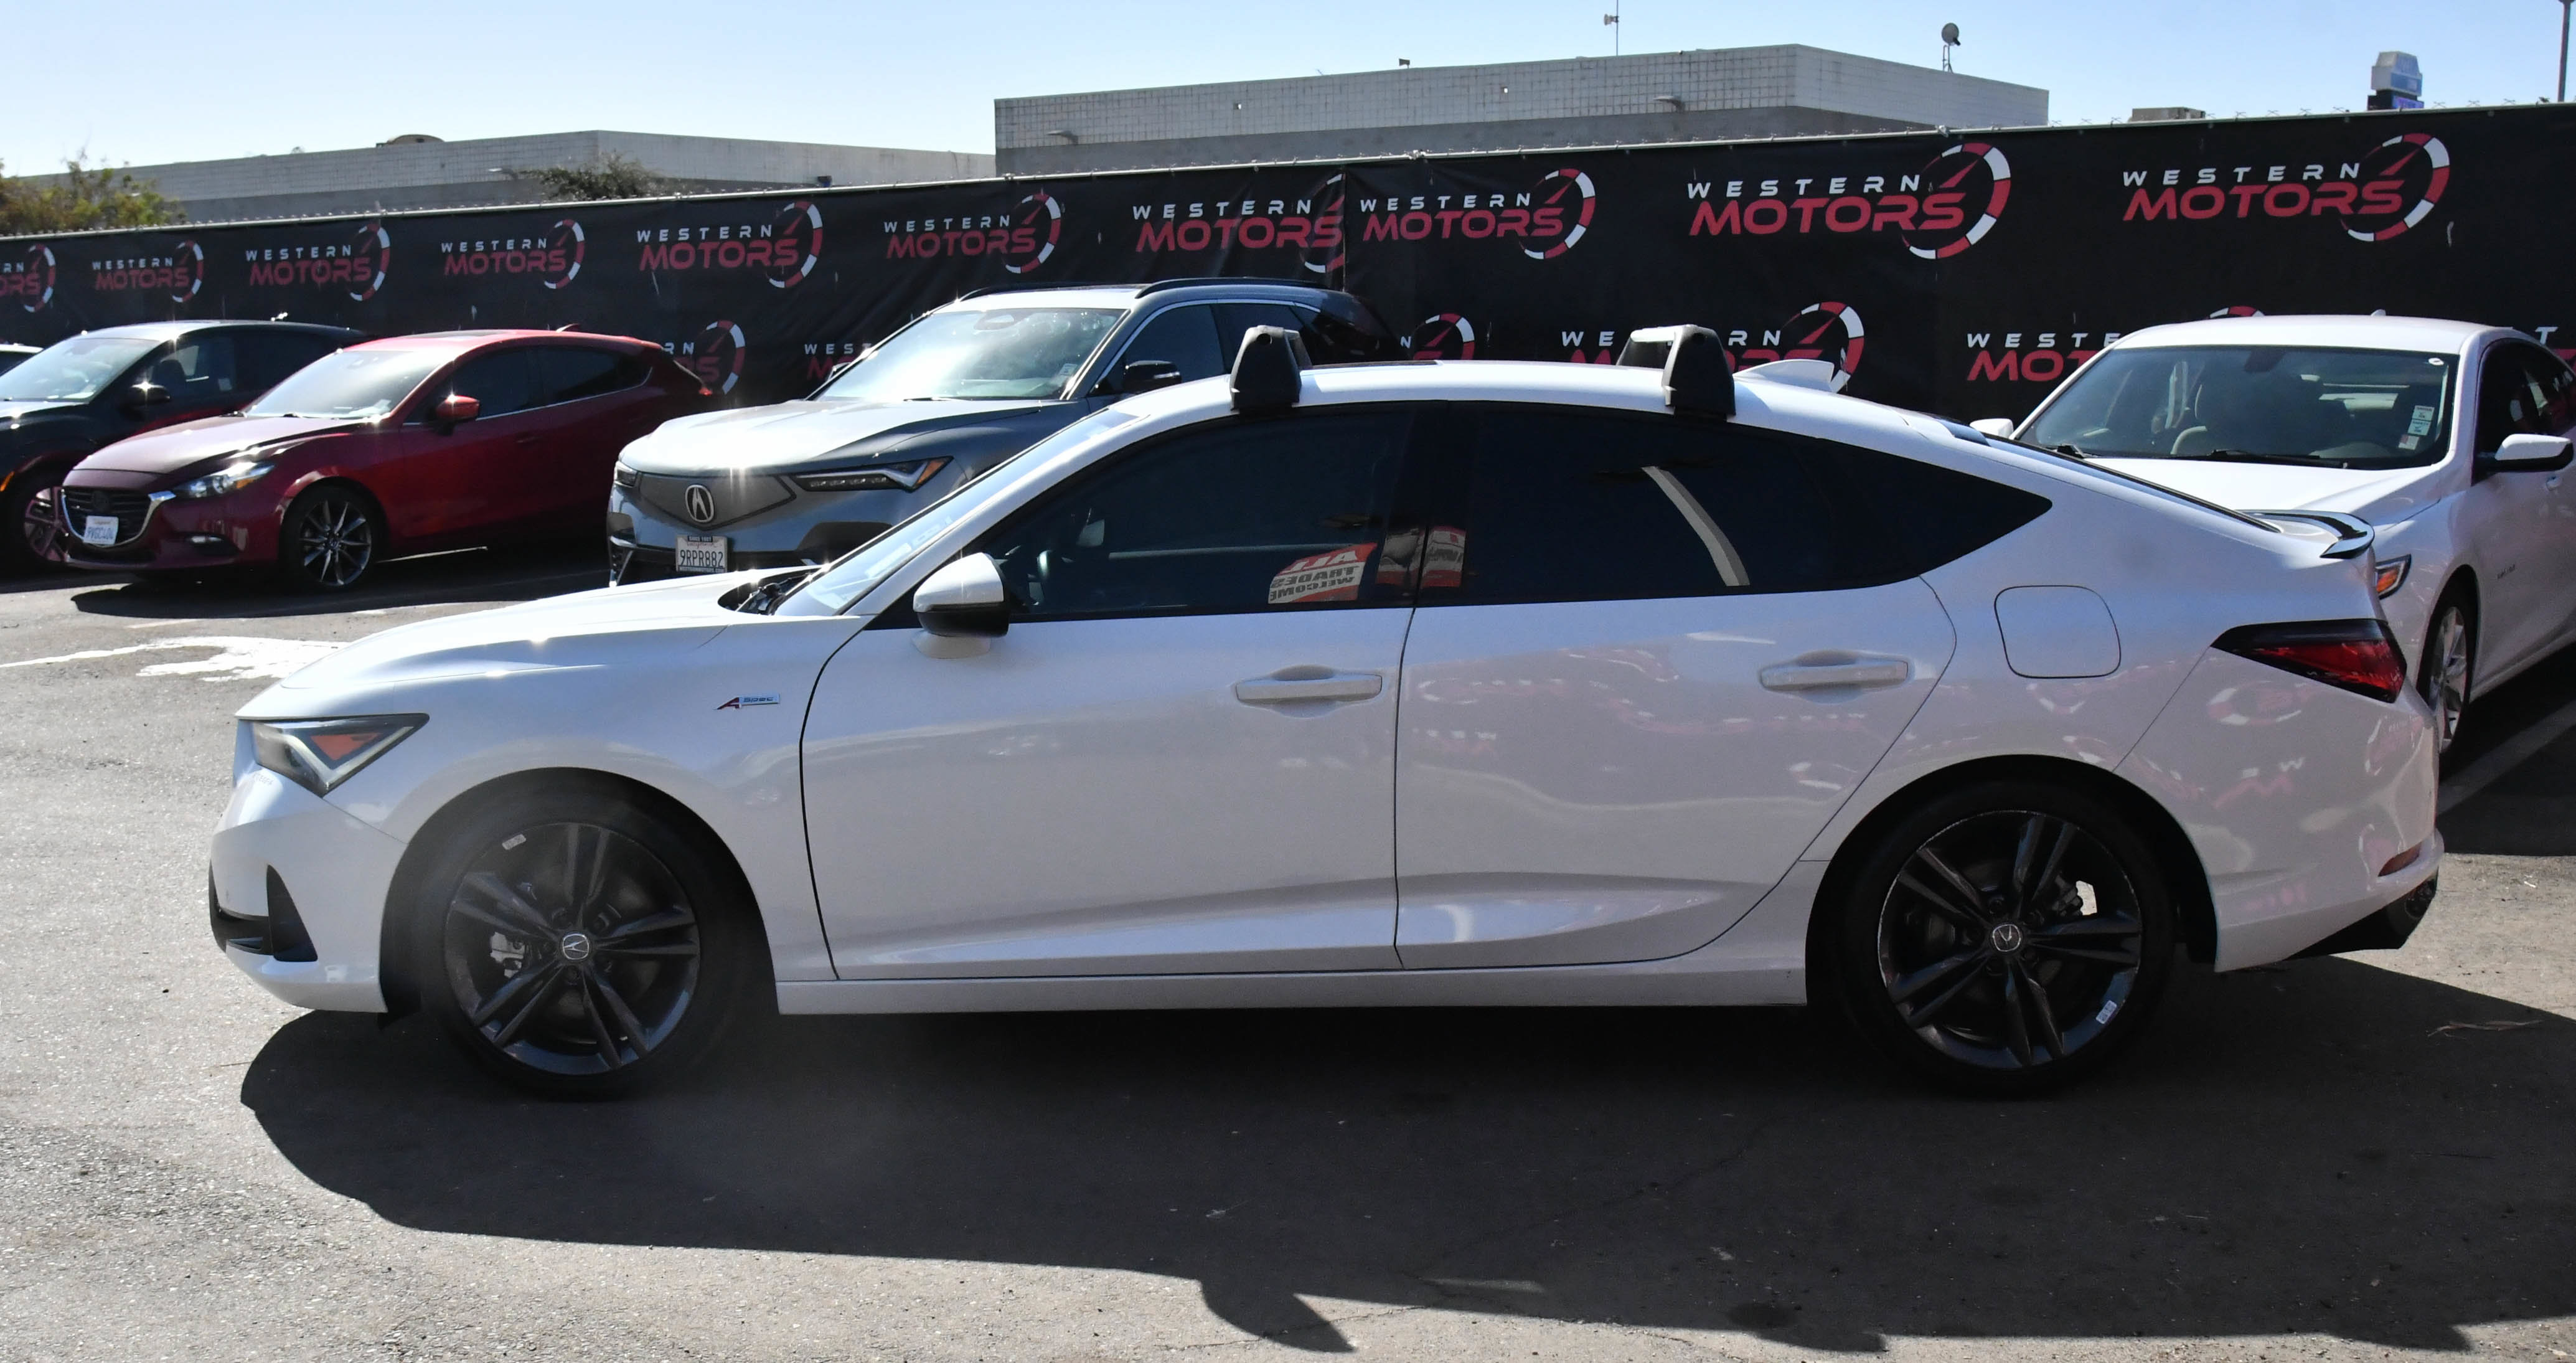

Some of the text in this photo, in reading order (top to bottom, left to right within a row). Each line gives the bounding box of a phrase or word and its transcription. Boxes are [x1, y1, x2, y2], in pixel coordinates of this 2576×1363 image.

[2123, 163, 2360, 187] WESTERN
[1688, 175, 1920, 199] WESTERN
[1133, 199, 1311, 220] WESTERN
[1361, 193, 1531, 212] WESTERN
[2123, 180, 2404, 222] MOTORS
[884, 215, 1010, 232] WESTERN
[1363, 207, 1564, 242] MOTORS
[1690, 192, 1966, 237] MOTORS
[637, 225, 772, 242] WESTERN
[887, 227, 1037, 258] MOTORS
[1136, 215, 1343, 252] MOTORS
[246, 245, 351, 261] WESTERN
[441, 238, 547, 253] WESTERN
[640, 239, 799, 271] MOTORS
[92, 258, 172, 270] WESTERN
[250, 258, 370, 286] MOTORS
[444, 250, 566, 275] MOTORS
[97, 268, 189, 291] MOTORS
[1562, 330, 1781, 347] WERN
[1967, 332, 2121, 347] WESTE
[1967, 350, 2098, 382] MOT
[680, 550, 723, 568] 9RPR882
